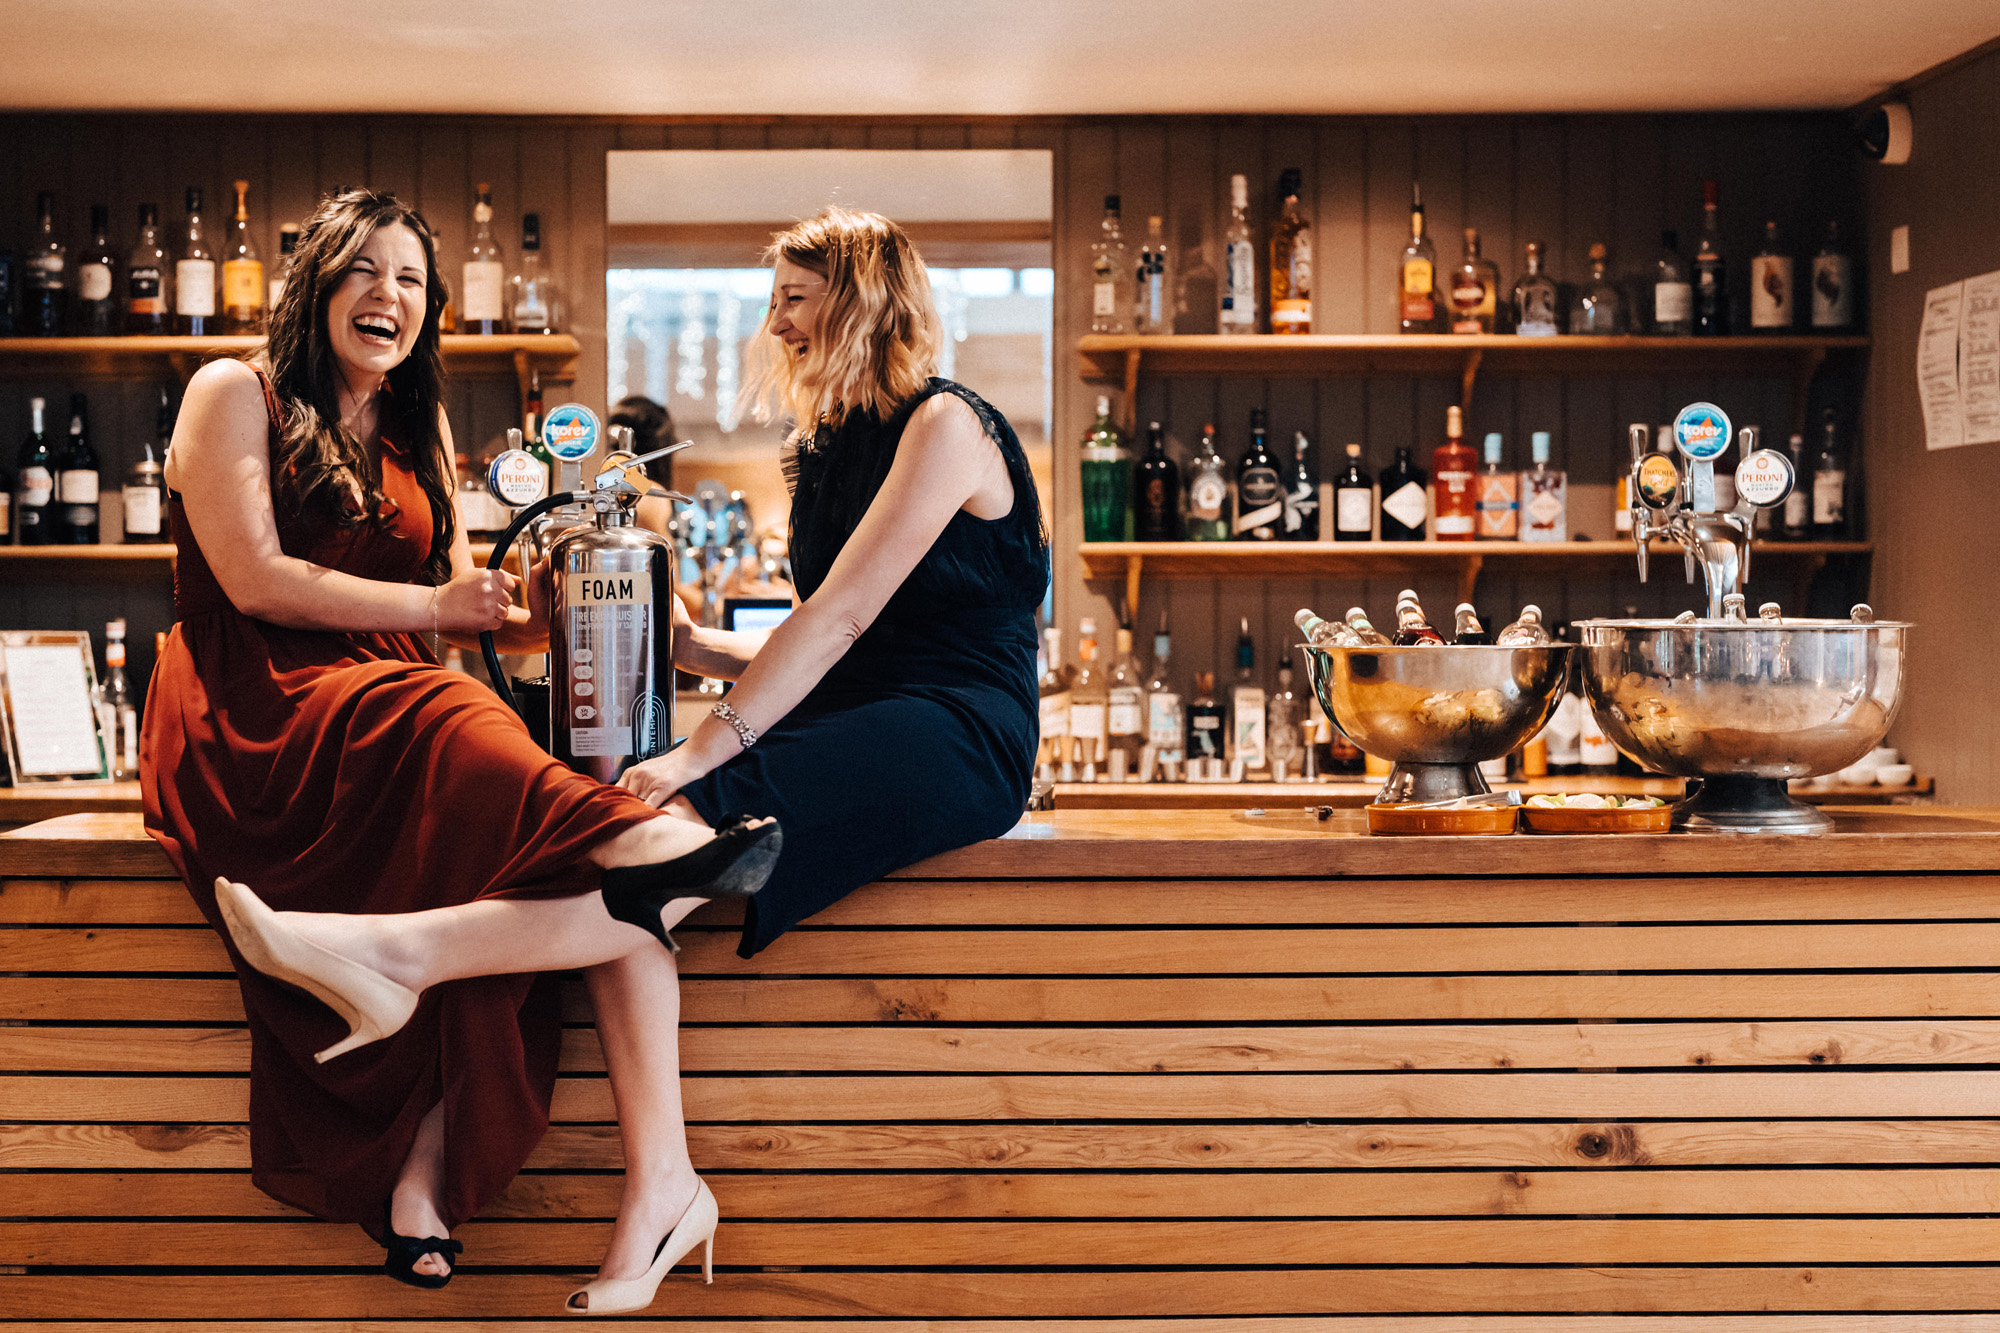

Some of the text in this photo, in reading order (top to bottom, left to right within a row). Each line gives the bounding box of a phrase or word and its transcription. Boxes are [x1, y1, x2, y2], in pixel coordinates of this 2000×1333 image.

[551, 424, 591, 438] korev
[1684, 423, 1723, 438] korev
[501, 473, 540, 484] PERONI
[1741, 473, 1783, 483] PERONI
[582, 579, 633, 600] FOAM
